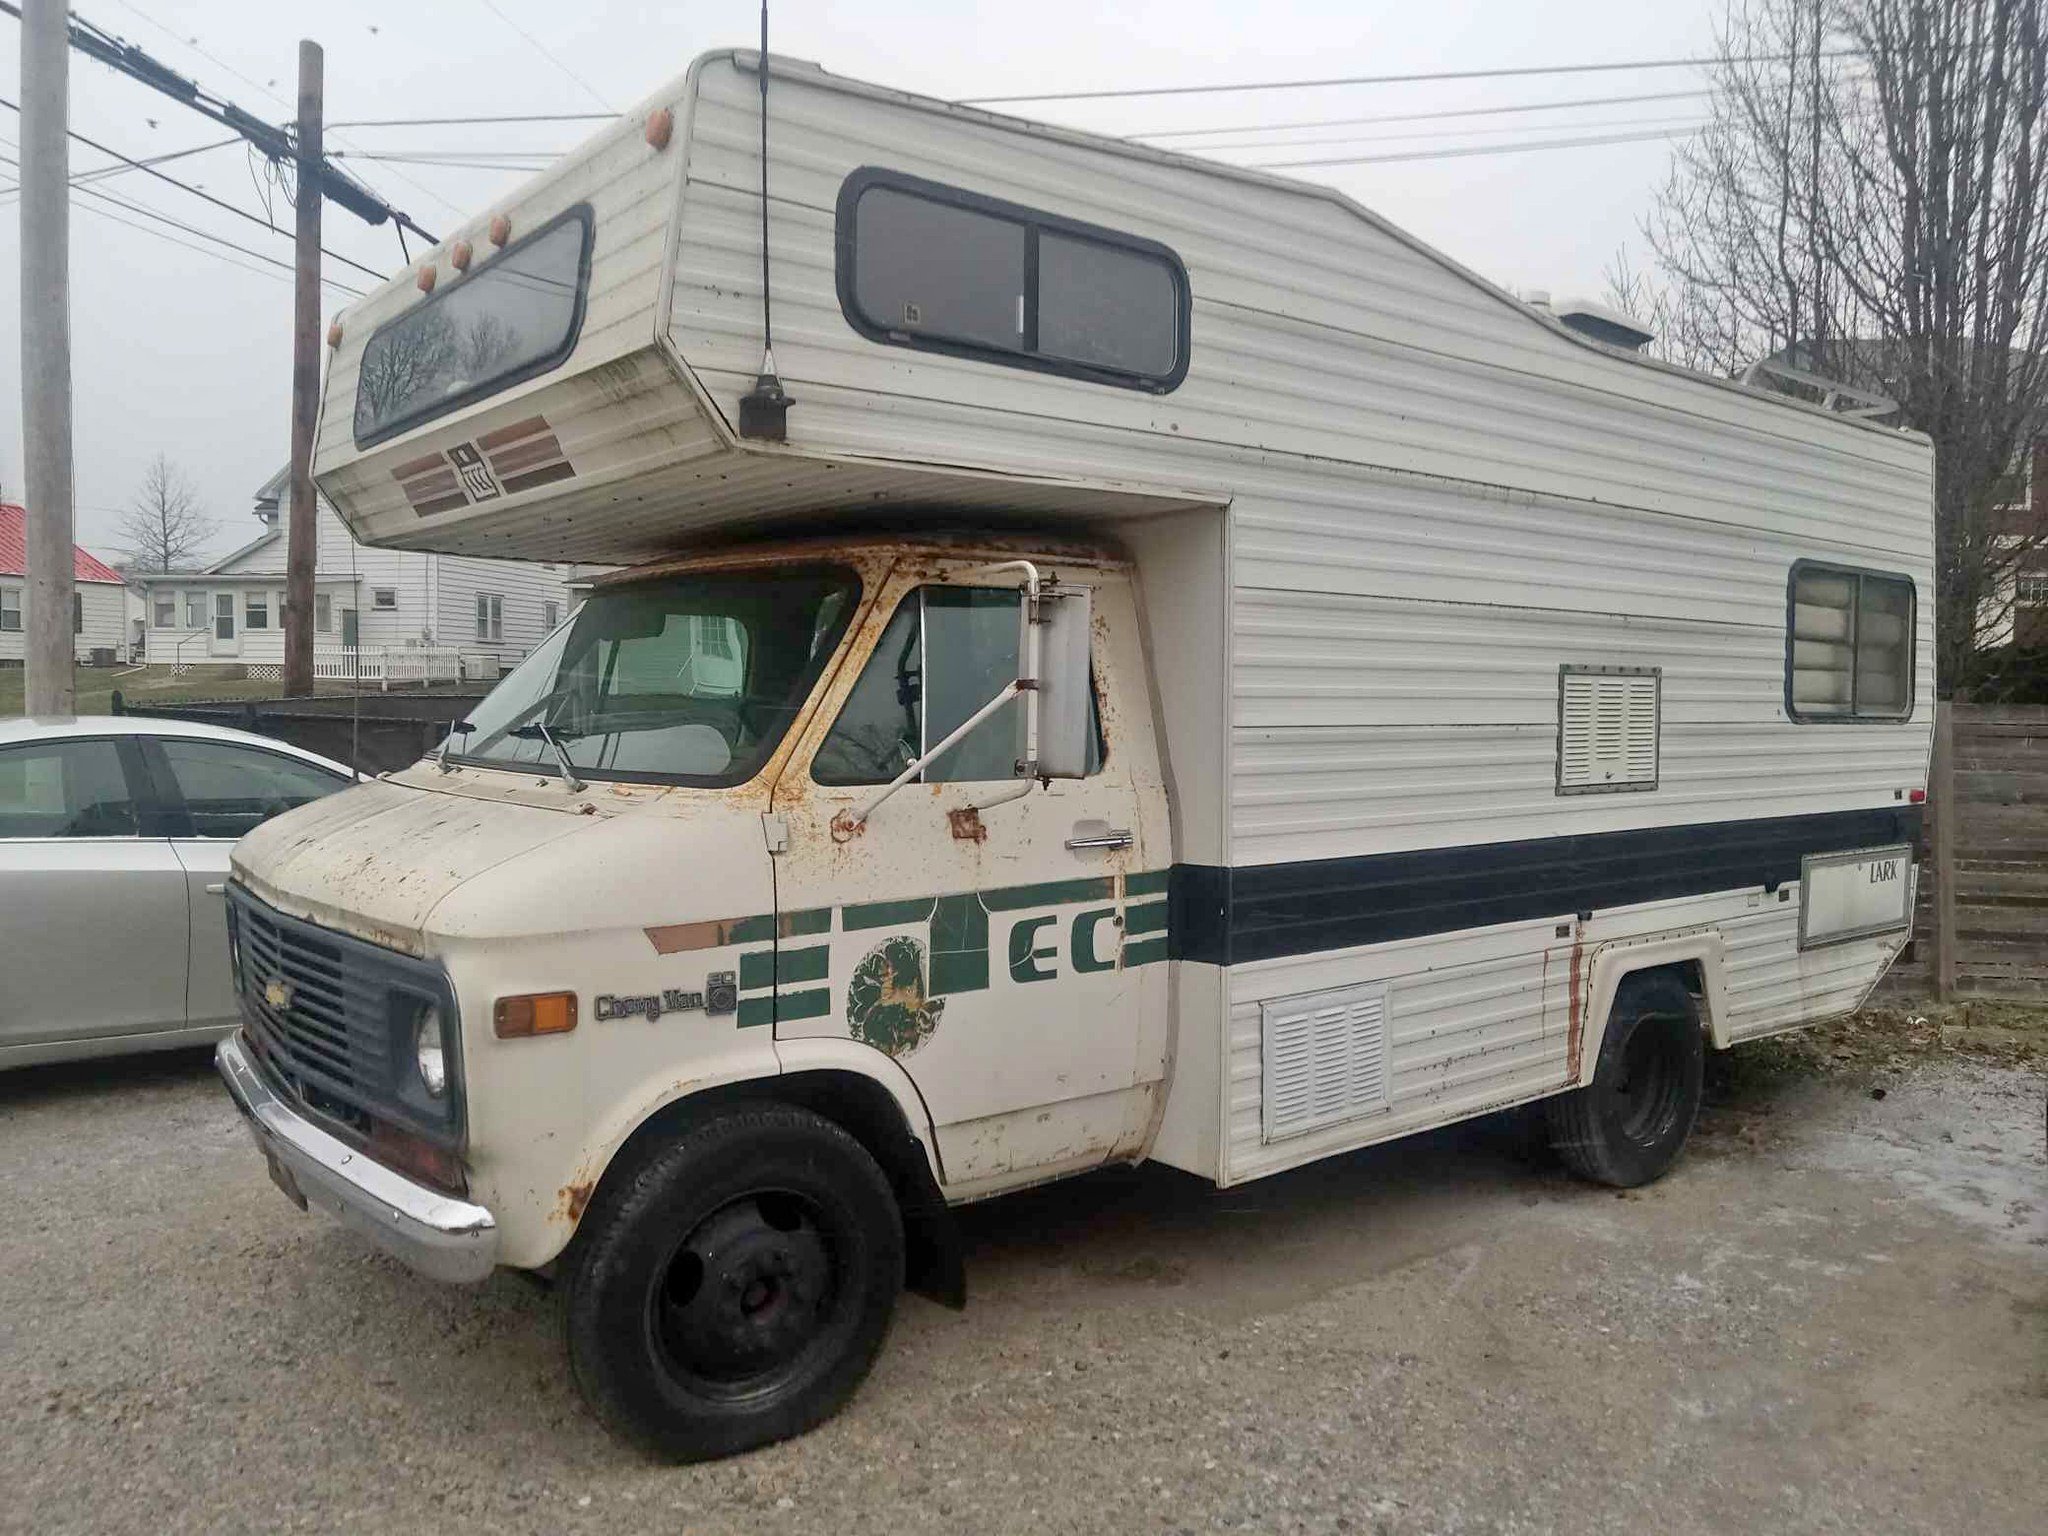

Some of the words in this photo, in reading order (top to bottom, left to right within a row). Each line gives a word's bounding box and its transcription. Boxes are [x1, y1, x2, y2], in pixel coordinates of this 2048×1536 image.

[1870, 860, 1898, 883] LARK
[594, 993, 660, 1023] Chevy
[662, 988, 704, 1011] Van
